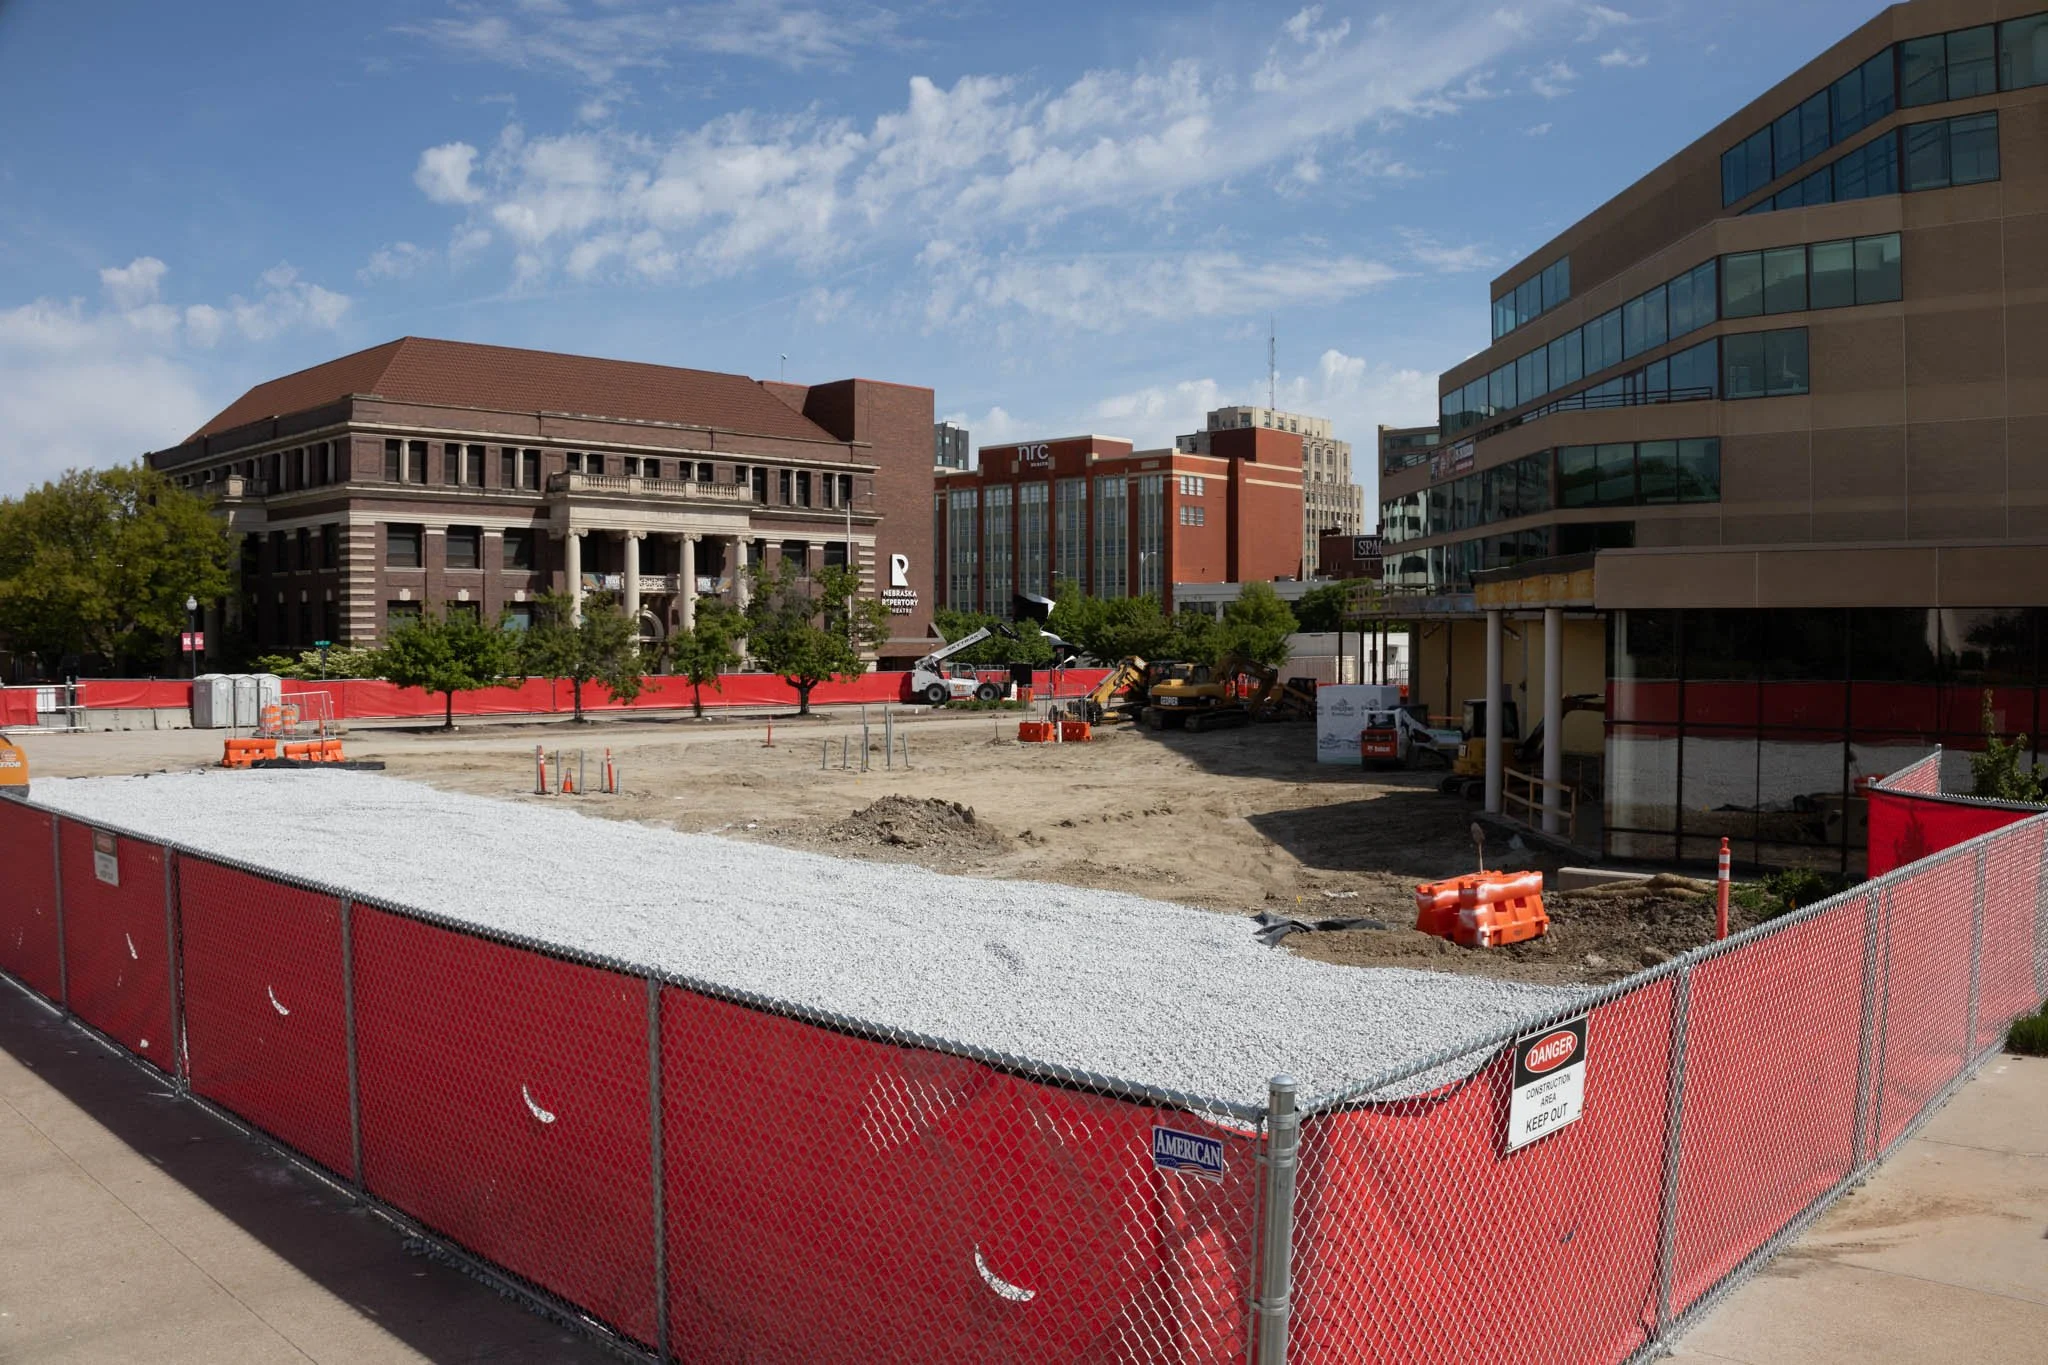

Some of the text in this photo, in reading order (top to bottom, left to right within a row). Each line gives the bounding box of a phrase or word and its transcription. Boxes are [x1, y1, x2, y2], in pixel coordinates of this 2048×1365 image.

[1018, 444, 1049, 462] nrc
[881, 598, 919, 606] REPERTORY
[883, 589, 918, 597] NEBRASKA
[1530, 1035, 1573, 1067] DANGER
[1526, 1073, 1571, 1100] CONSTRUCTION
[1540, 1093, 1557, 1107] AREA
[1526, 1103, 1568, 1134] KEEP OUT
[1156, 1130, 1221, 1168] AMERICAN
